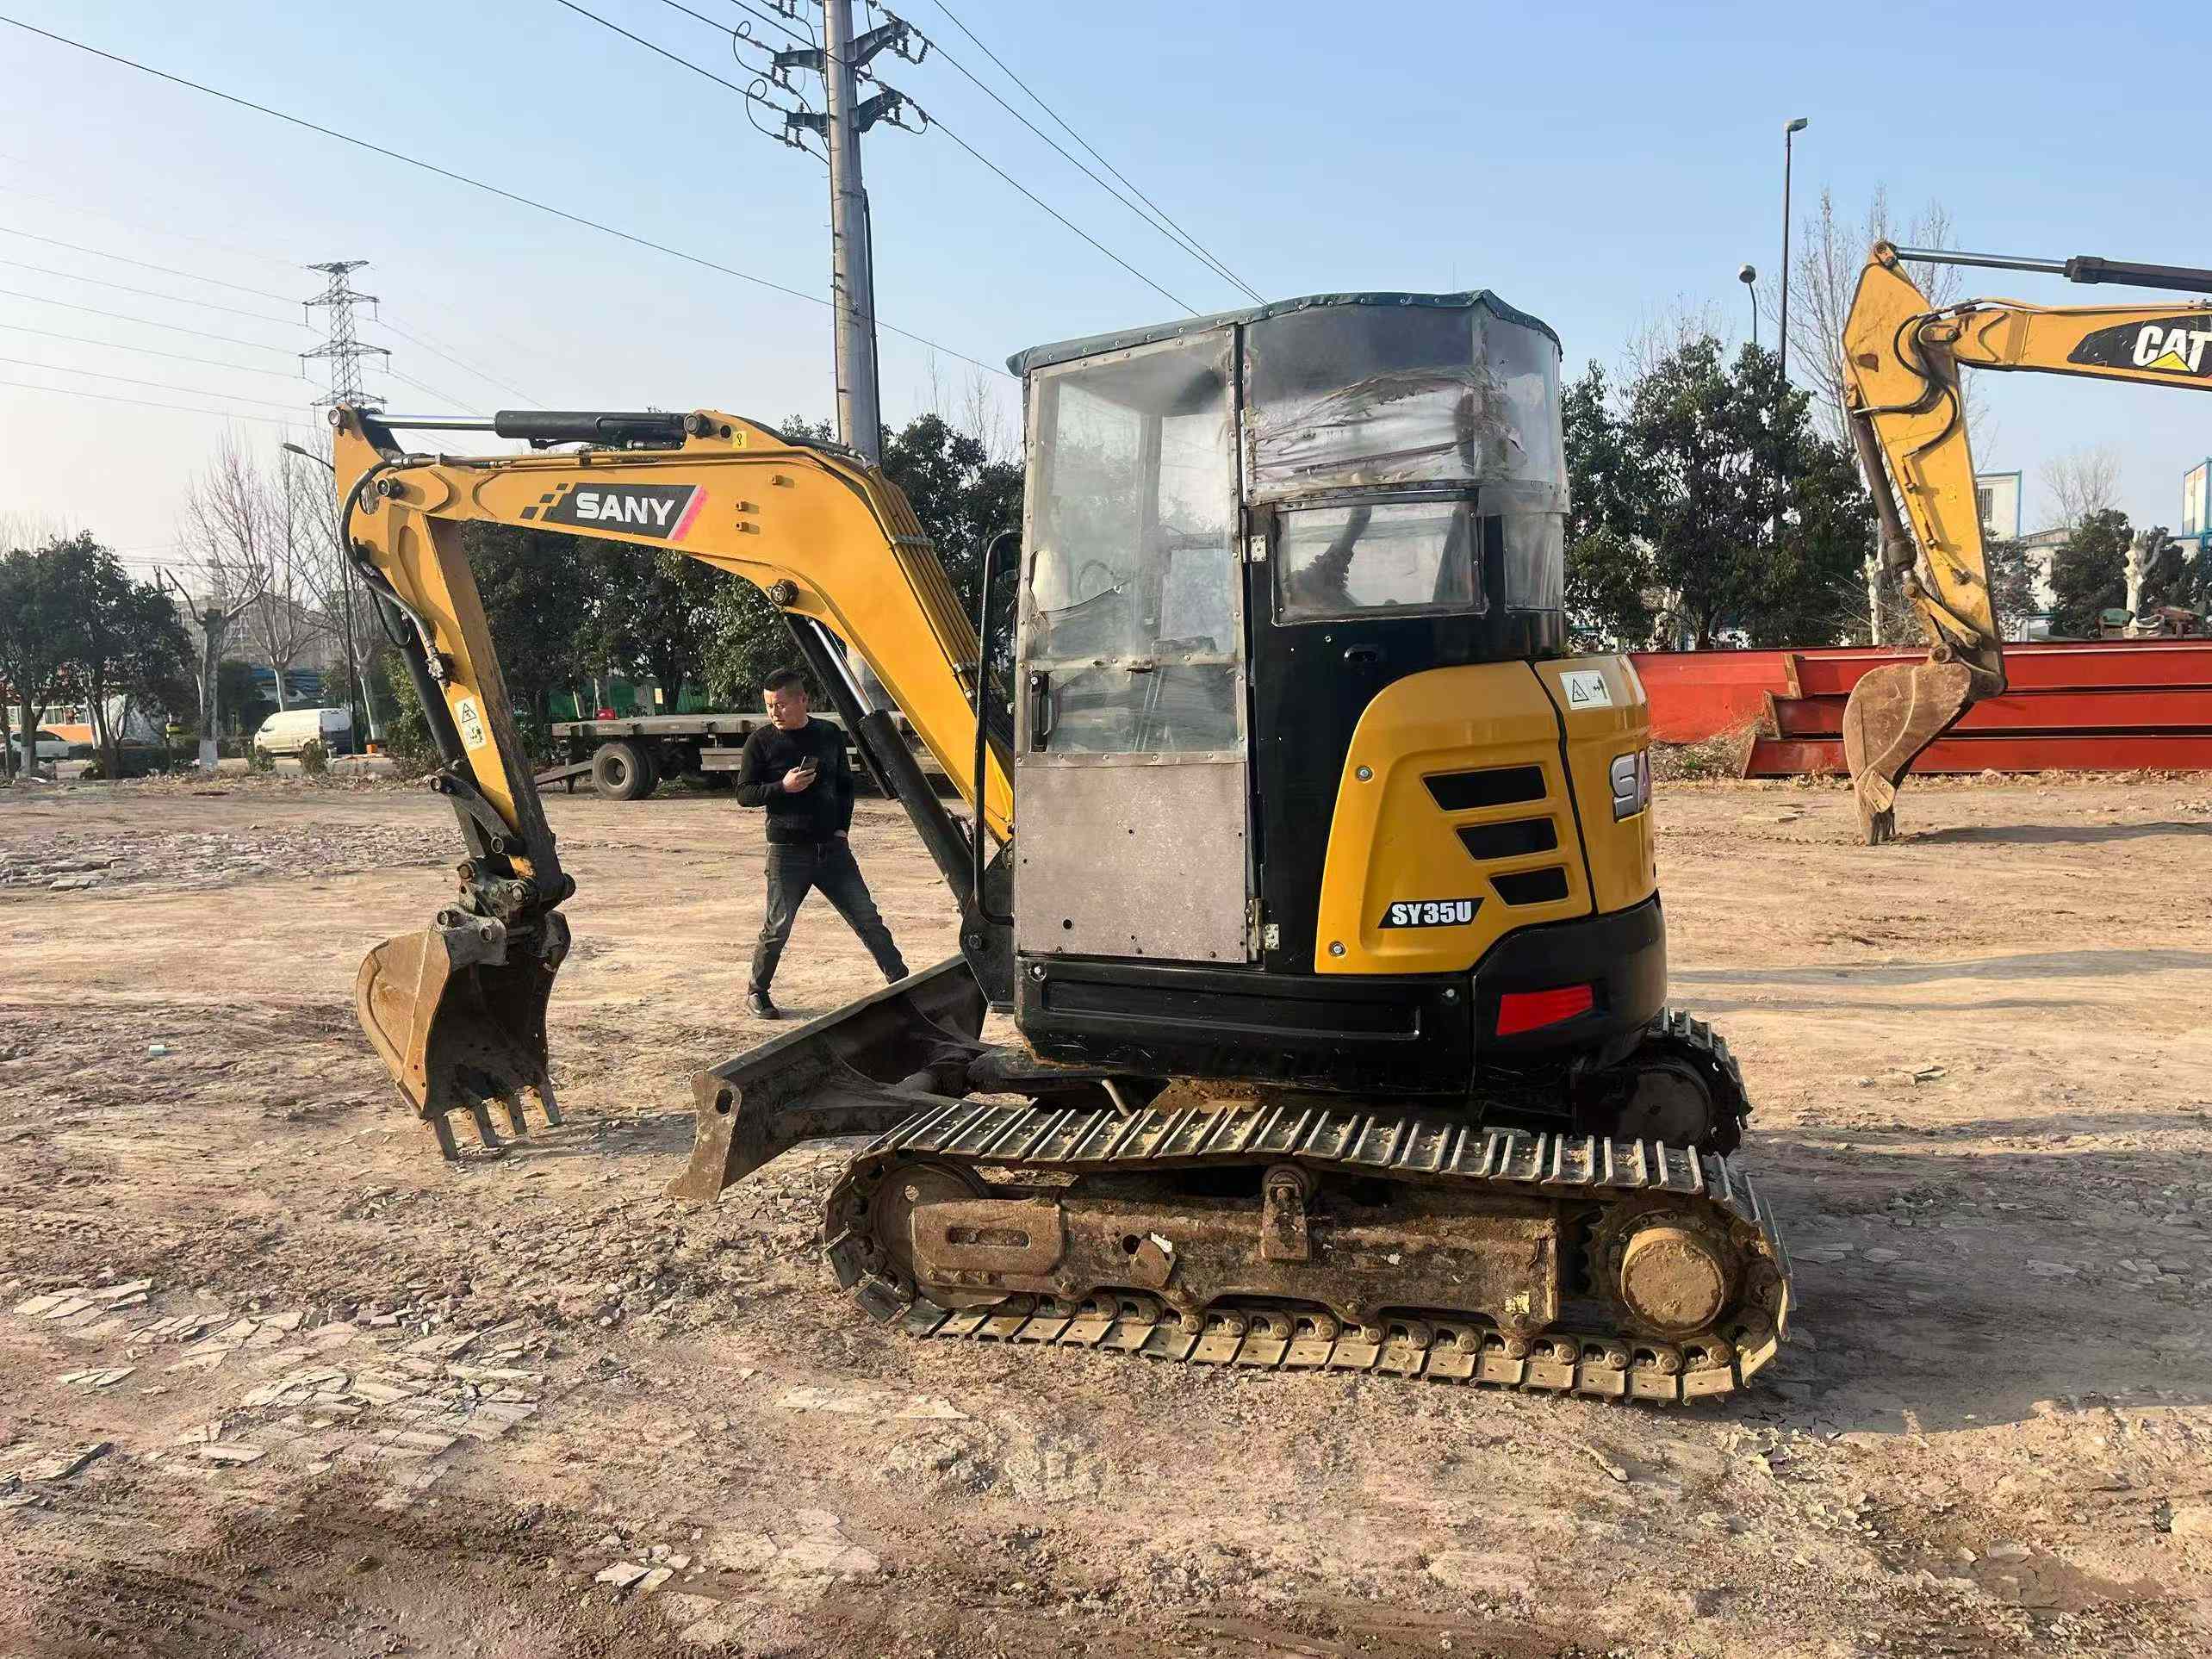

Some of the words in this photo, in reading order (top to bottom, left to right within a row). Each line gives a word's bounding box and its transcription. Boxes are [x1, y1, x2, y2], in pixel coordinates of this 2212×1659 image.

[2133, 325, 2212, 372] CAT
[576, 492, 675, 526] SANY
[1391, 901, 1472, 925] SY35U
